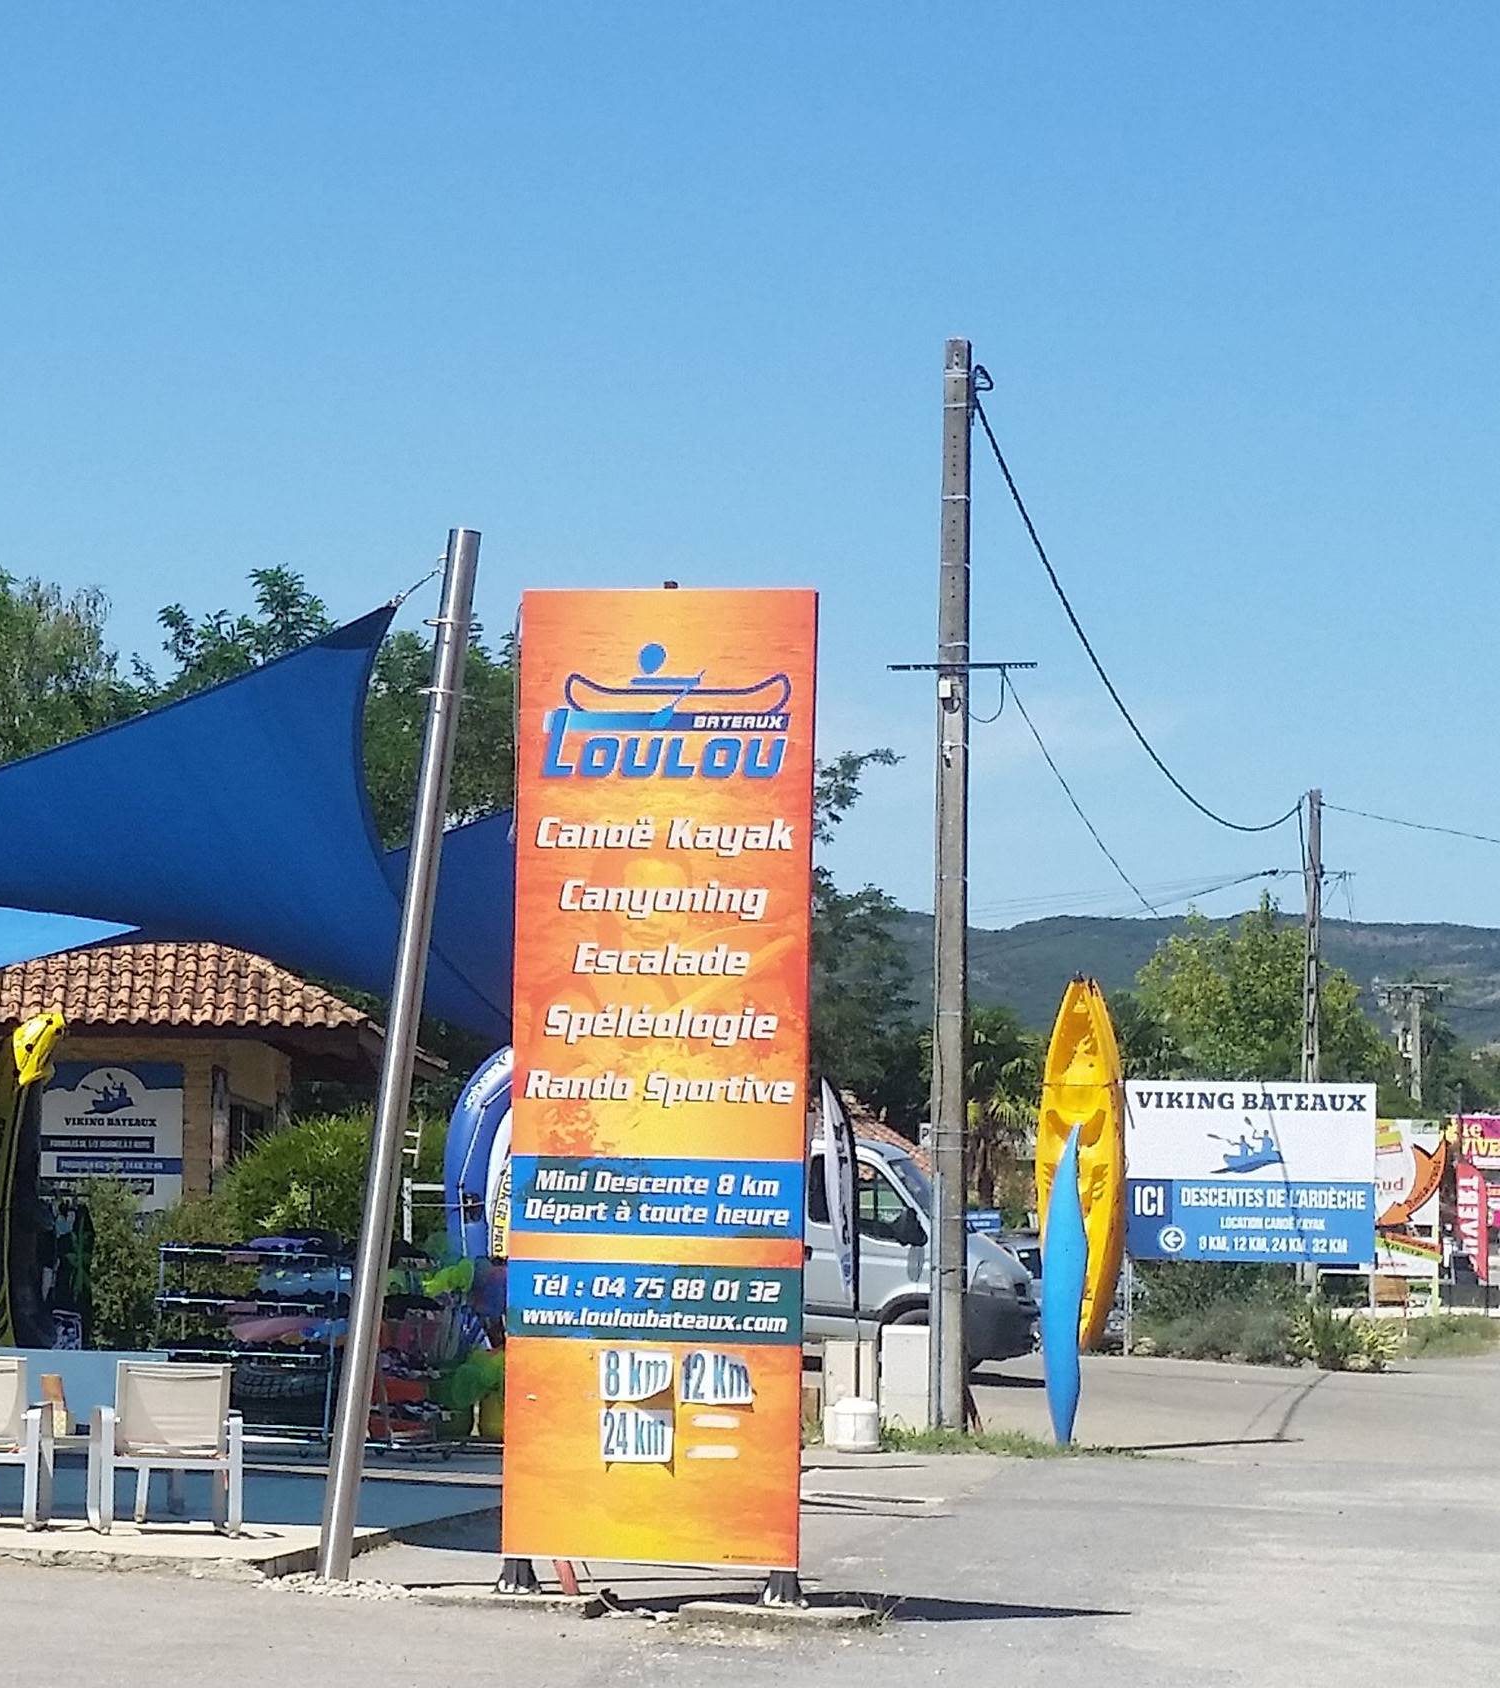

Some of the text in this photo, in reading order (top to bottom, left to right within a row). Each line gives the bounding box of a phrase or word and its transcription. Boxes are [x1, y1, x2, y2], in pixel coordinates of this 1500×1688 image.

[692, 714, 785, 730] BATEAUX
[543, 708, 789, 779] LOULOU
[536, 816, 794, 857] Canoë Kayak
[559, 879, 770, 921] Canyoning
[573, 942, 751, 977] Escalade
[544, 1004, 779, 1046] Spéléologie
[524, 1069, 797, 1107] Rando Sportive
[1136, 1091, 1368, 1112] VIKING BATEAUX
[64, 1117, 105, 1127] VIKING
[535, 1169, 780, 1198] Mini Descente 8 km
[524, 1197, 791, 1227] Départ à toute heure
[1134, 1186, 1164, 1216] ICI
[1181, 1186, 1264, 1208] DESCENTES
[1265, 1188, 1287, 1208] DE
[1220, 1216, 1263, 1230] LOCATION
[1233, 1236, 1247, 1251] 12
[1271, 1237, 1288, 1252] 24
[1312, 1238, 1329, 1253] 32
[1329, 1238, 1349, 1254] KM
[532, 1274, 569, 1296] Tél
[592, 1275, 627, 1299] 04
[633, 1277, 667, 1300] 75
[671, 1278, 706, 1301] 88
[711, 1279, 740, 1301] 01
[746, 1280, 782, 1303] 32
[522, 1307, 789, 1333] www.louloubateaux.com
[604, 1350, 669, 1397] 8 km
[682, 1353, 706, 1400] 12
[604, 1411, 667, 1456] 24 km
